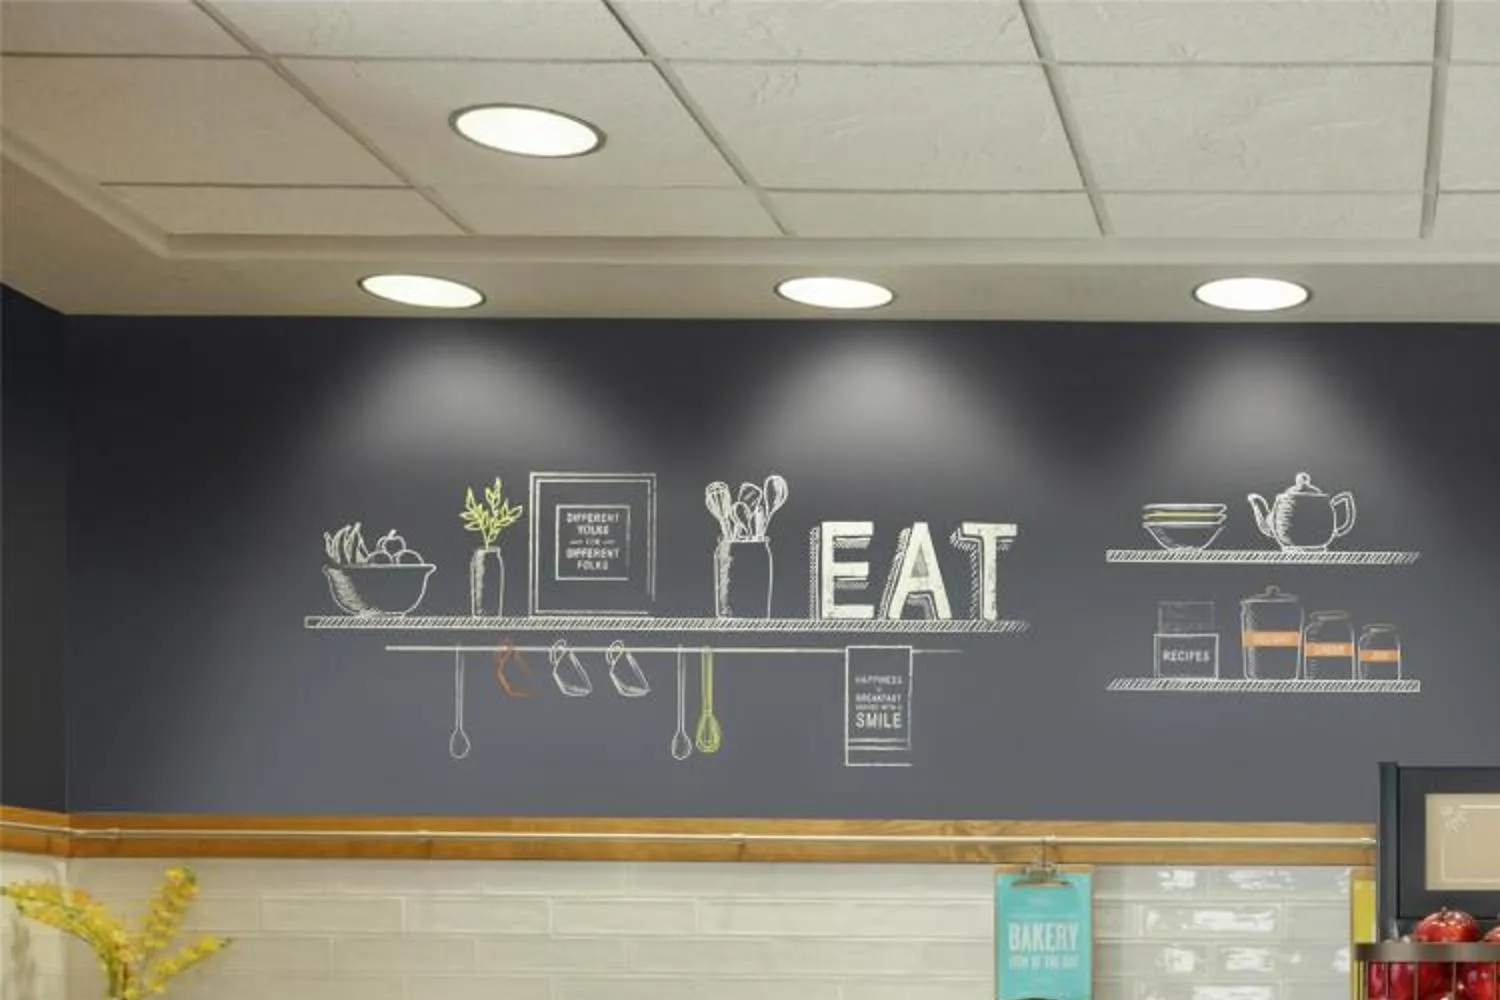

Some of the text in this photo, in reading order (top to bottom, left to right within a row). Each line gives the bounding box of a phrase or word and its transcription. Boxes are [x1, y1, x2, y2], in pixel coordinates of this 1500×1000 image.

[810, 521, 1018, 620] EAT
[1163, 649, 1210, 662] RECIPES
[855, 711, 902, 729] SMILE
[1008, 922, 1080, 952] BAKERY
